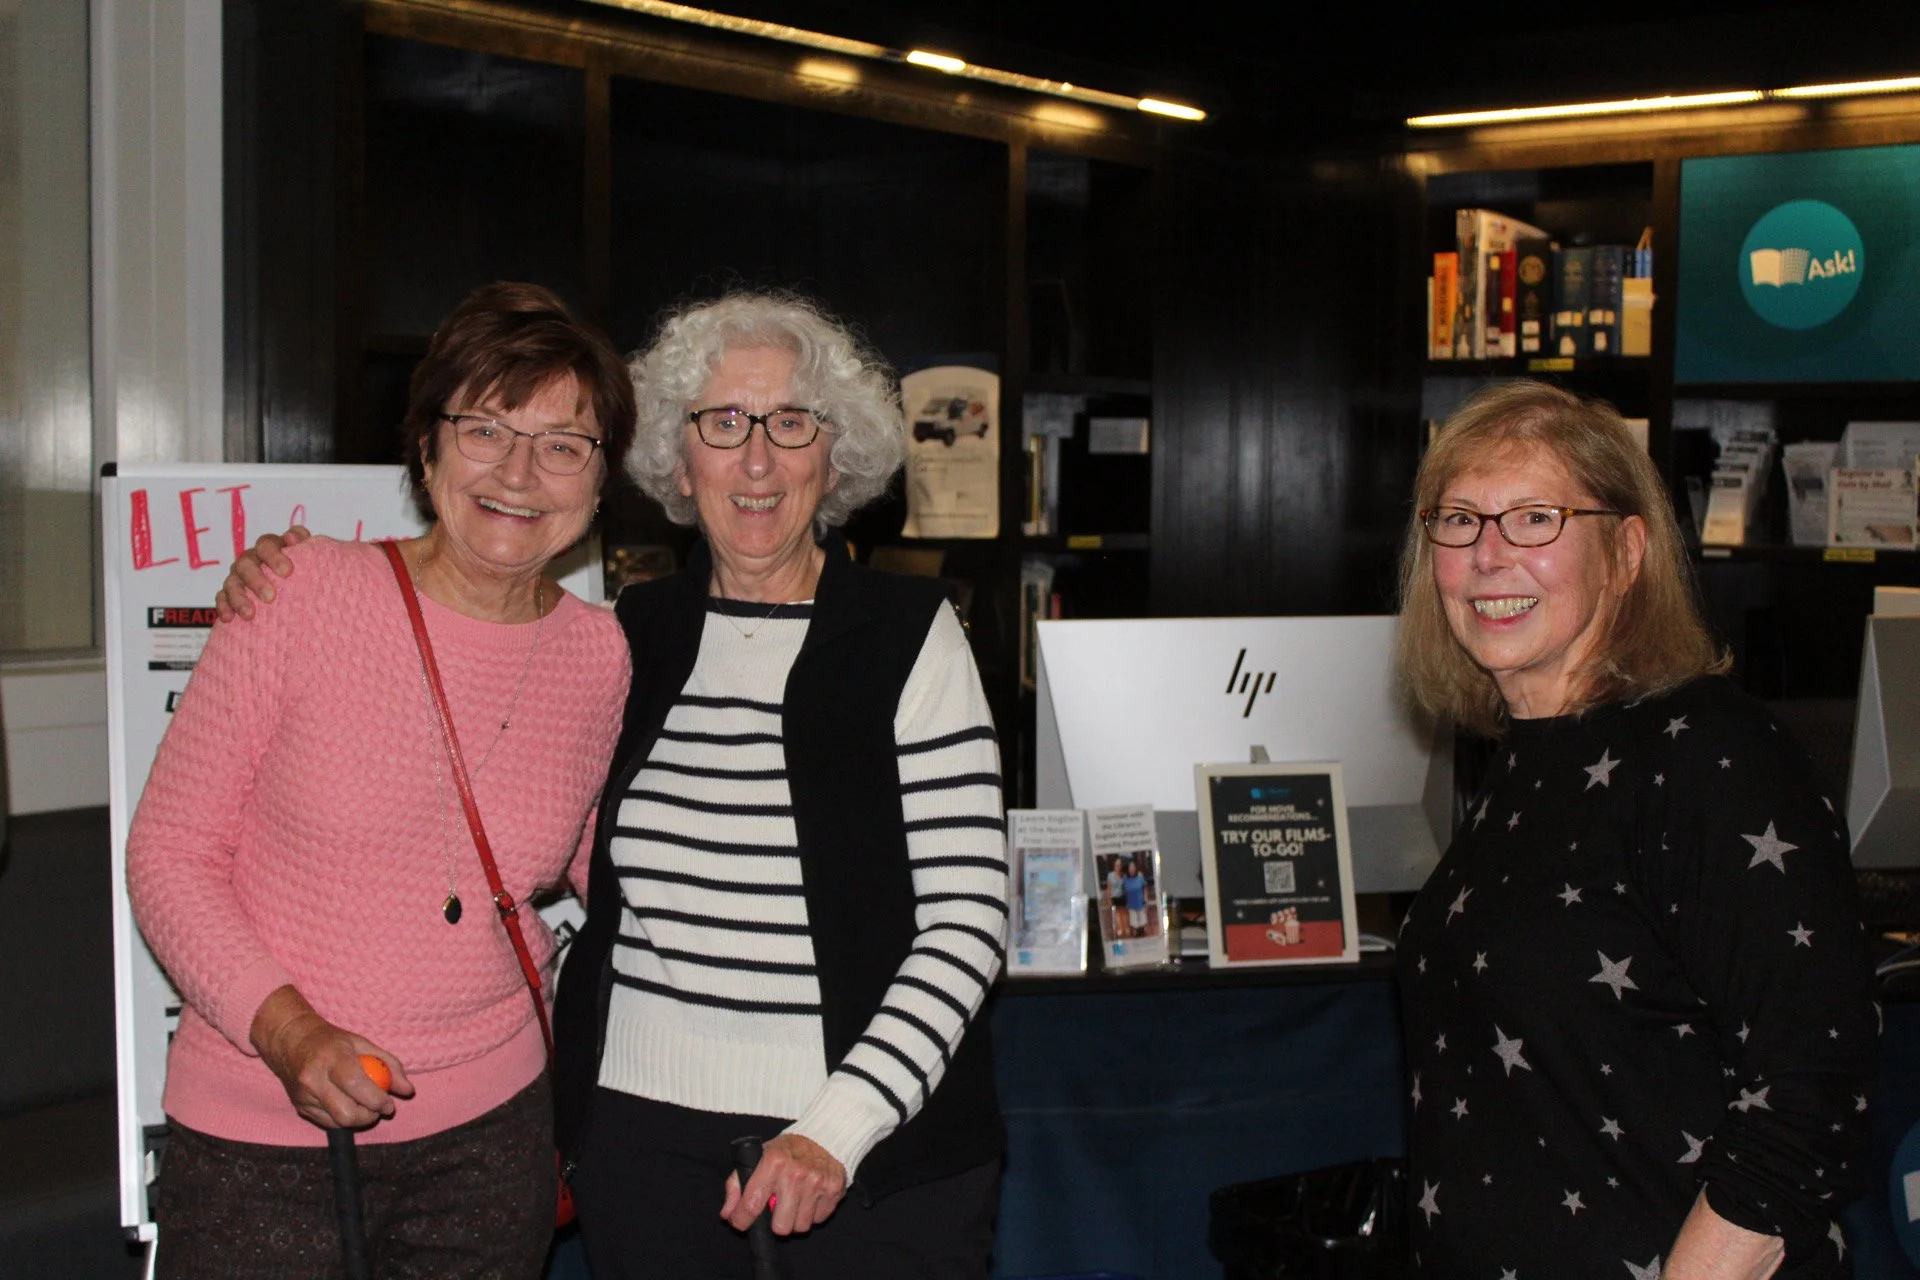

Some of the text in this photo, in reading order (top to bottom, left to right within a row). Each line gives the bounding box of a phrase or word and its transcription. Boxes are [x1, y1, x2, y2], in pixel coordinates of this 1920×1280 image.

[1808, 249, 1856, 280] Ask!
[130, 484, 251, 571] LET
[1226, 647, 1277, 718] hp
[1221, 827, 1331, 844] TRY OUR FILMS-
[1251, 842, 1305, 857] TO-GO!
